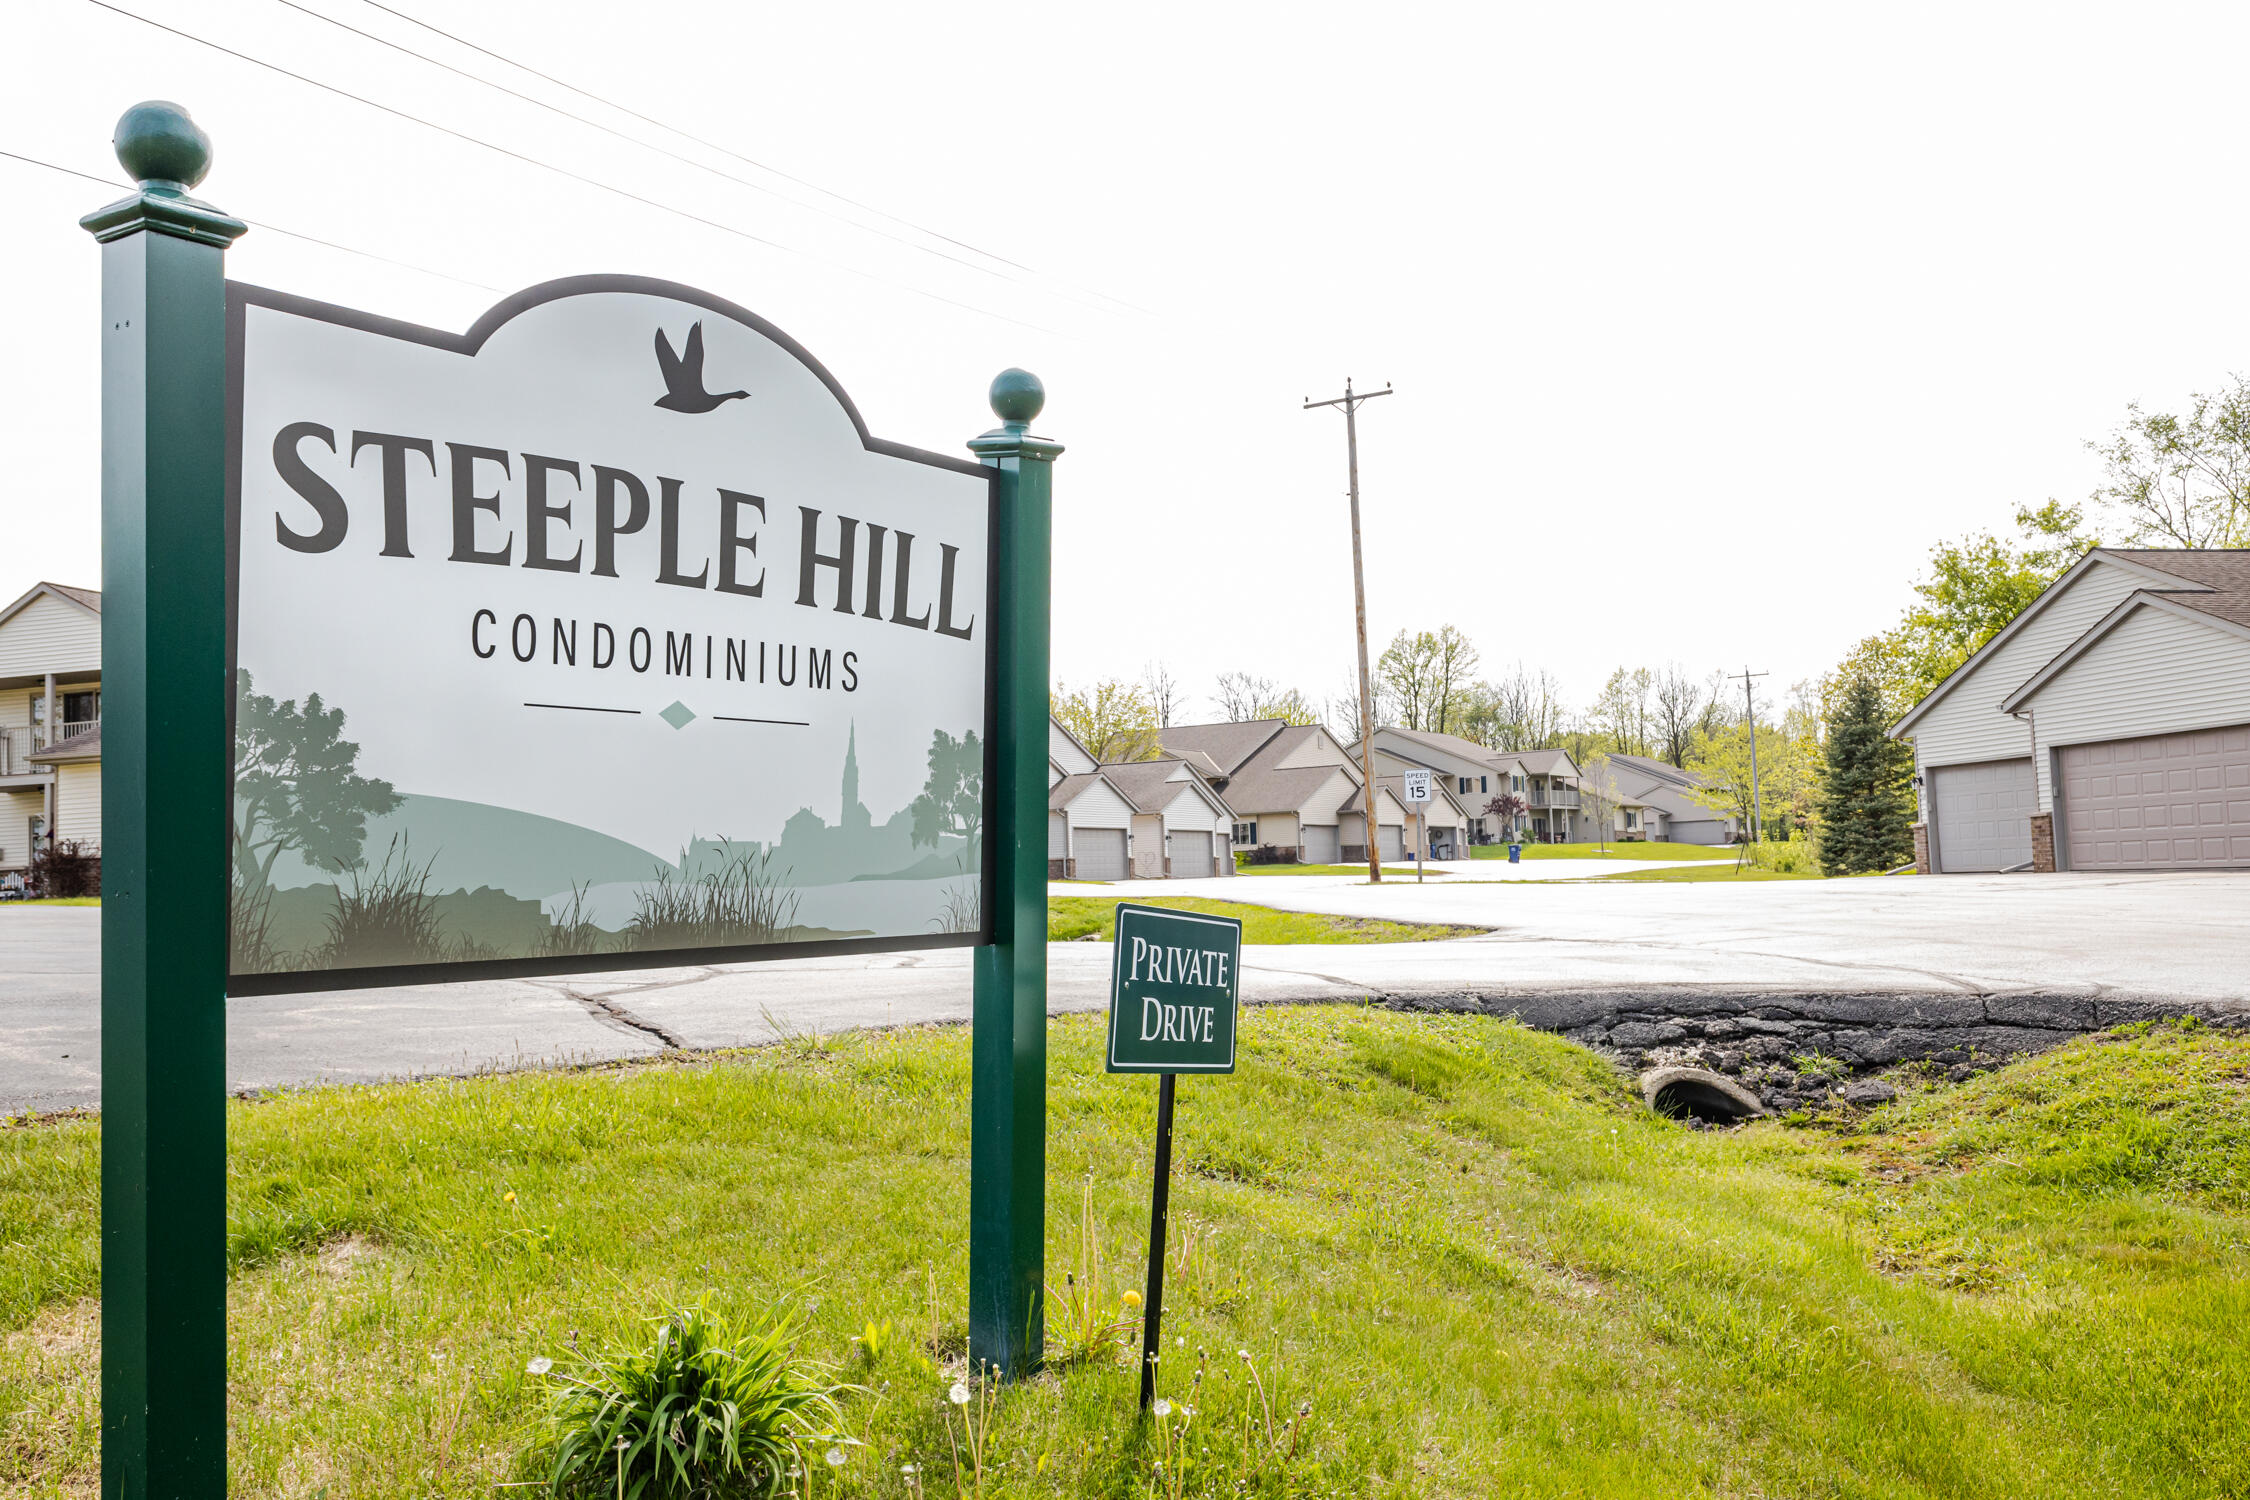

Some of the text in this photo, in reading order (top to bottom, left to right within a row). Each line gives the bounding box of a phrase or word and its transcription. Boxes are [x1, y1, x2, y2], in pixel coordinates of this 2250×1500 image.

[272, 421, 975, 641] STEEPLE HILL
[471, 609, 859, 692] CONDOMINIUMS
[1410, 786, 1426, 798] 15
[1129, 936, 1229, 988] PRIVATE
[1139, 996, 1215, 1043] DRIVE
